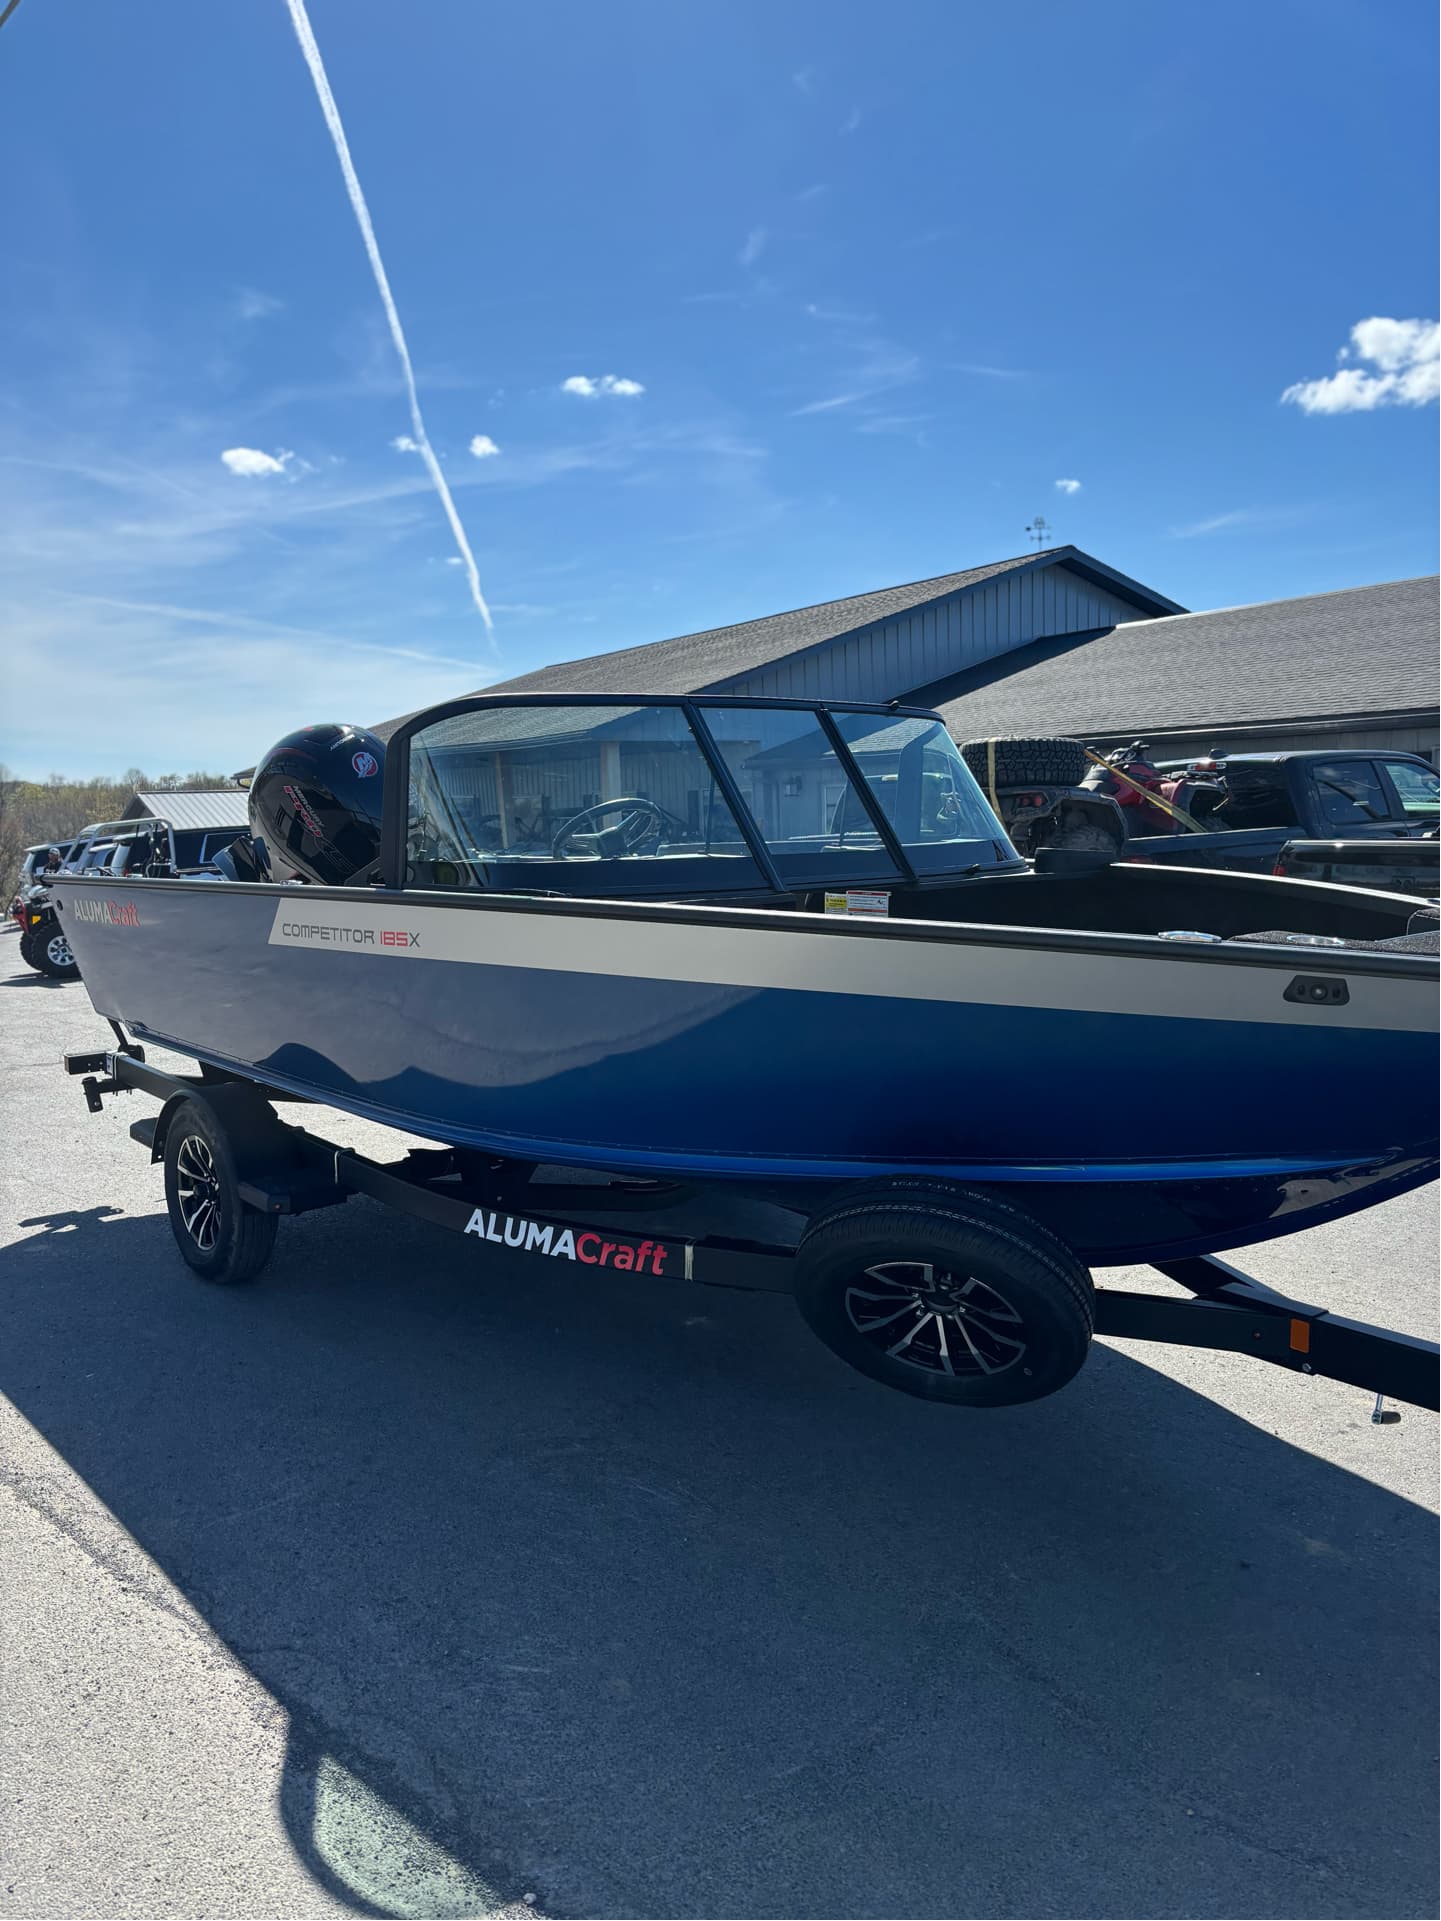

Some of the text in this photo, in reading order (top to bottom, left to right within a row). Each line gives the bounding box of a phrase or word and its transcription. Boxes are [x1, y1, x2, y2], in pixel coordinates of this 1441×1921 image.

[291, 785, 325, 828] MERCURY
[74, 899, 140, 928] ALUMACraft
[282, 922, 375, 945] COMPETITOR
[463, 1208, 668, 1275] ALUMACraft
